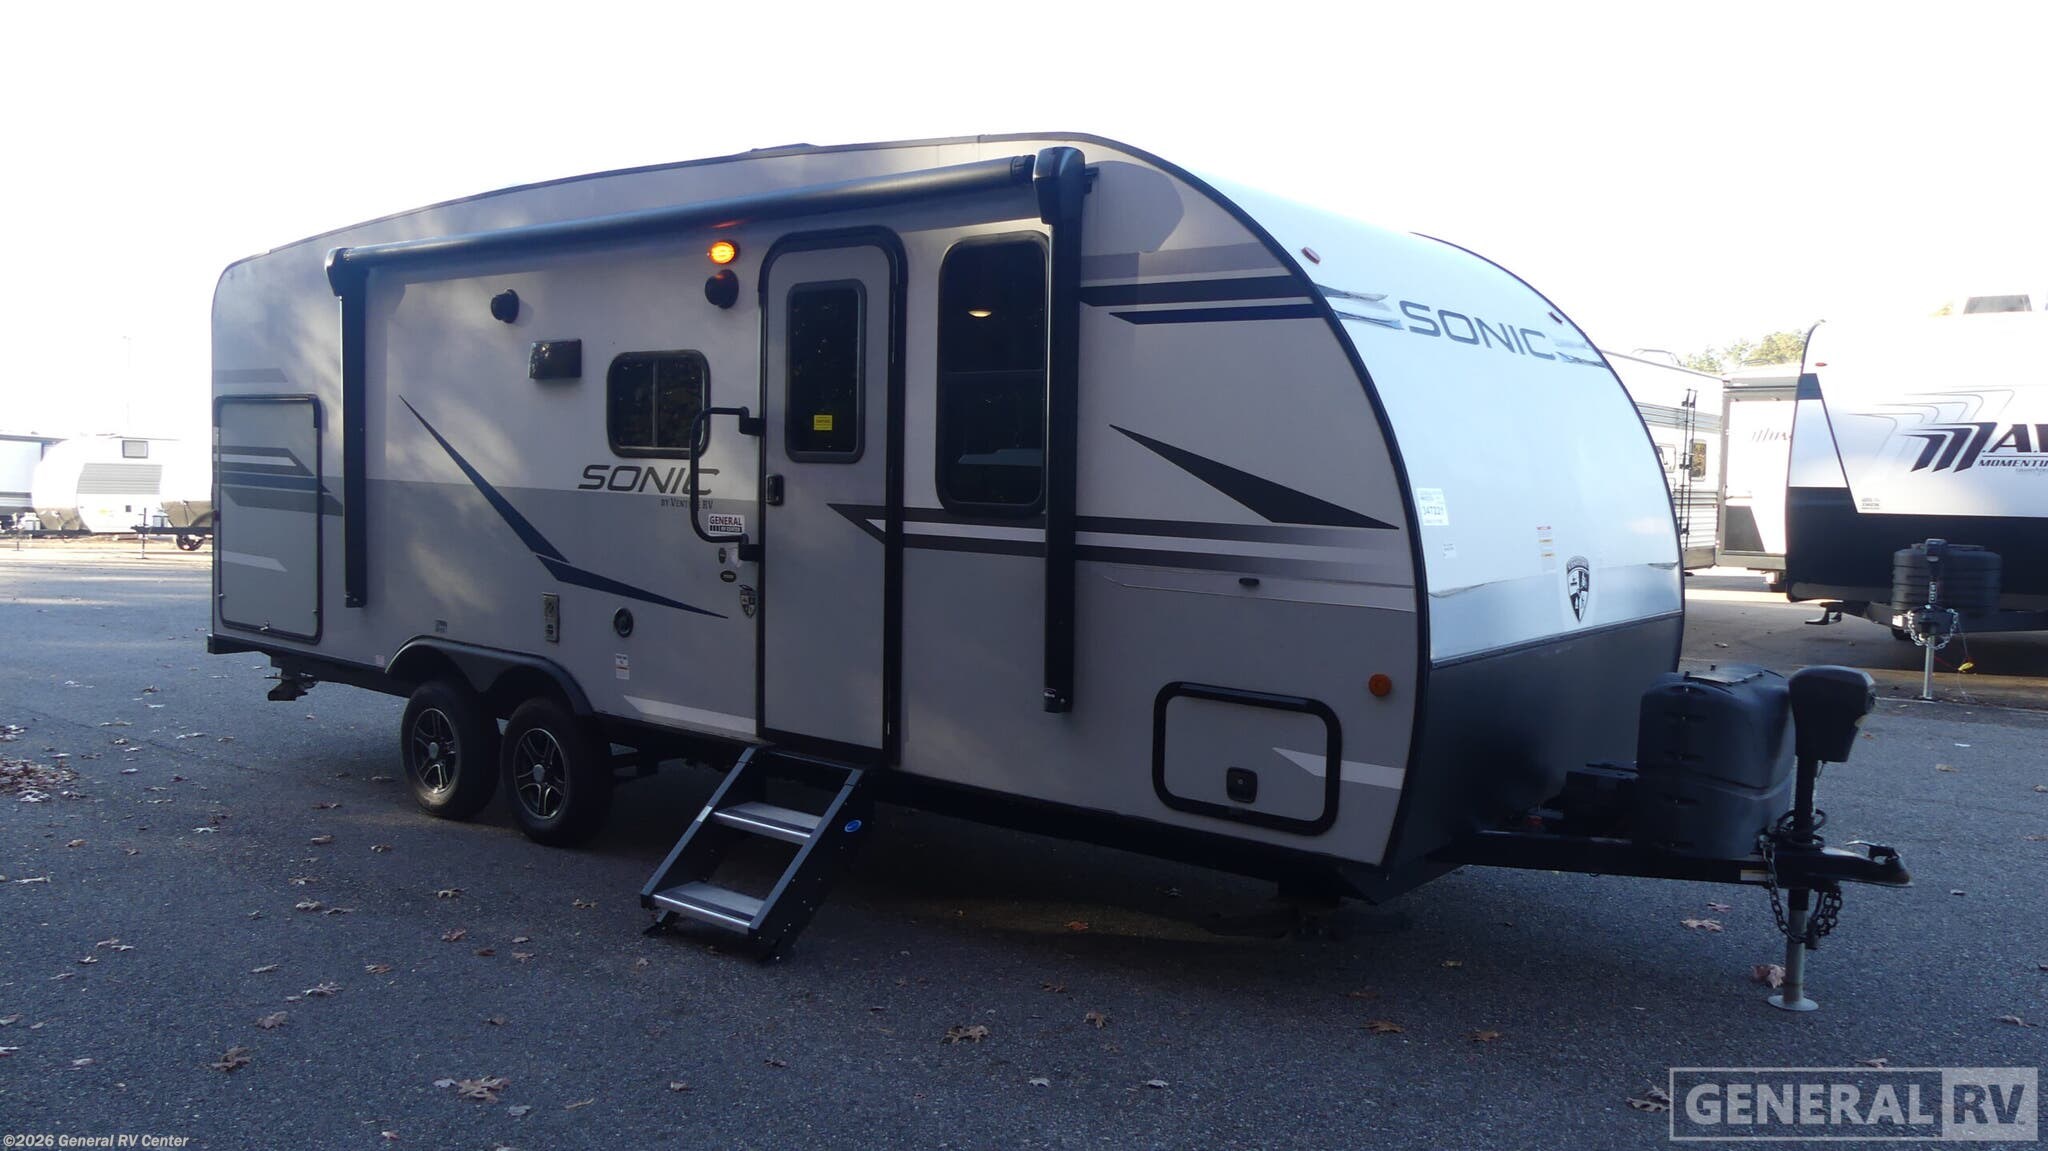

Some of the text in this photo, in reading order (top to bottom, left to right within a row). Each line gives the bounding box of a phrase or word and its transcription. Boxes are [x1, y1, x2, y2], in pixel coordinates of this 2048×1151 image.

[1399, 300, 1556, 360] SONIC
[578, 464, 720, 496] SONIC
[671, 498, 702, 509] VENT
[709, 516, 742, 526] GENERAL
